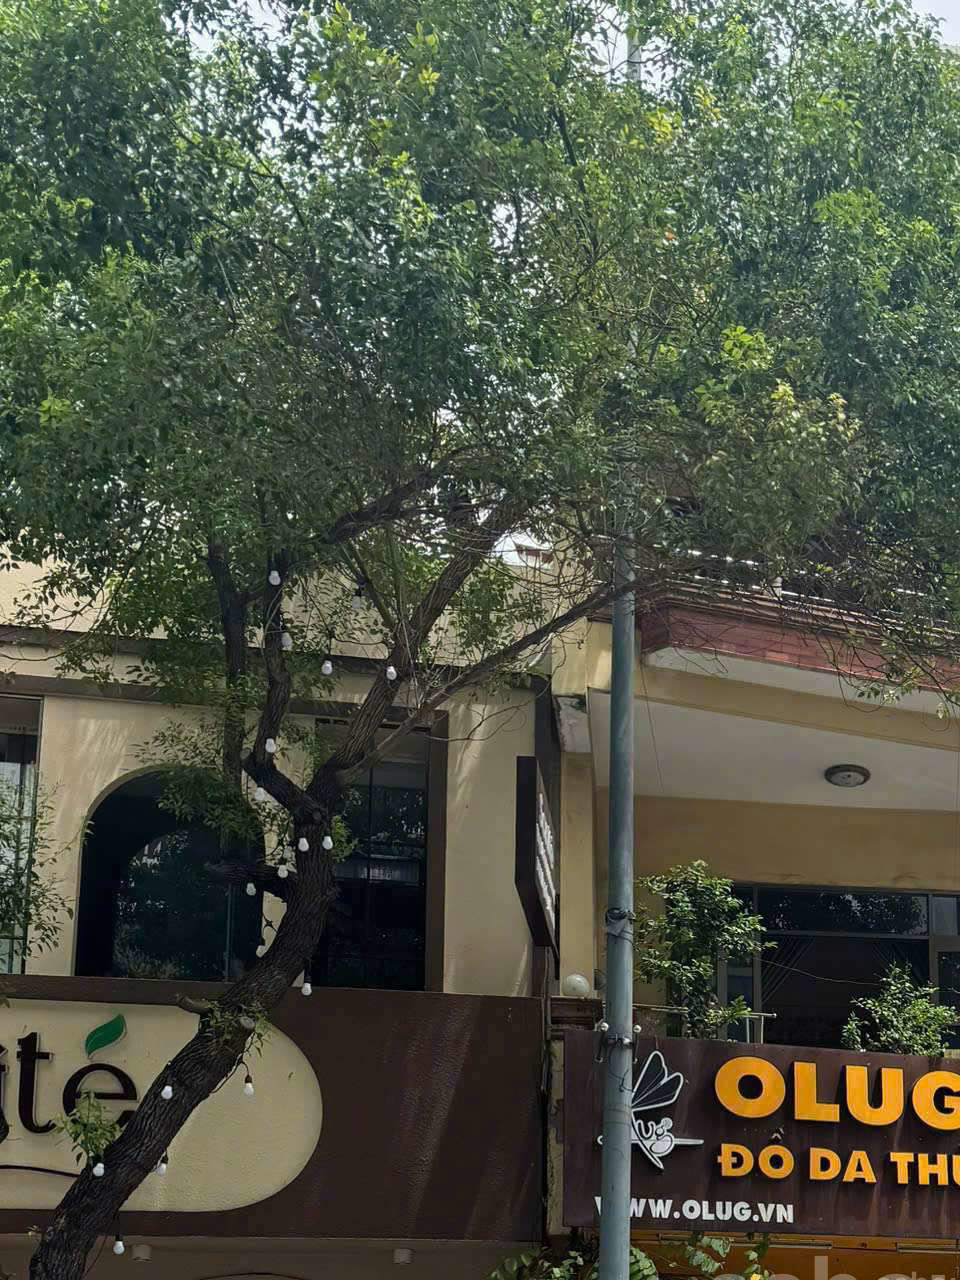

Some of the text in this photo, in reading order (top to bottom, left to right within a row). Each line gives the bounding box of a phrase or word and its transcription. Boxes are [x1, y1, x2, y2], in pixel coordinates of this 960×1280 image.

[717, 1128, 795, 1180] ĐỒ
[809, 1147, 877, 1183] DA
[594, 1196, 795, 1224] WW.OLUG.VN
